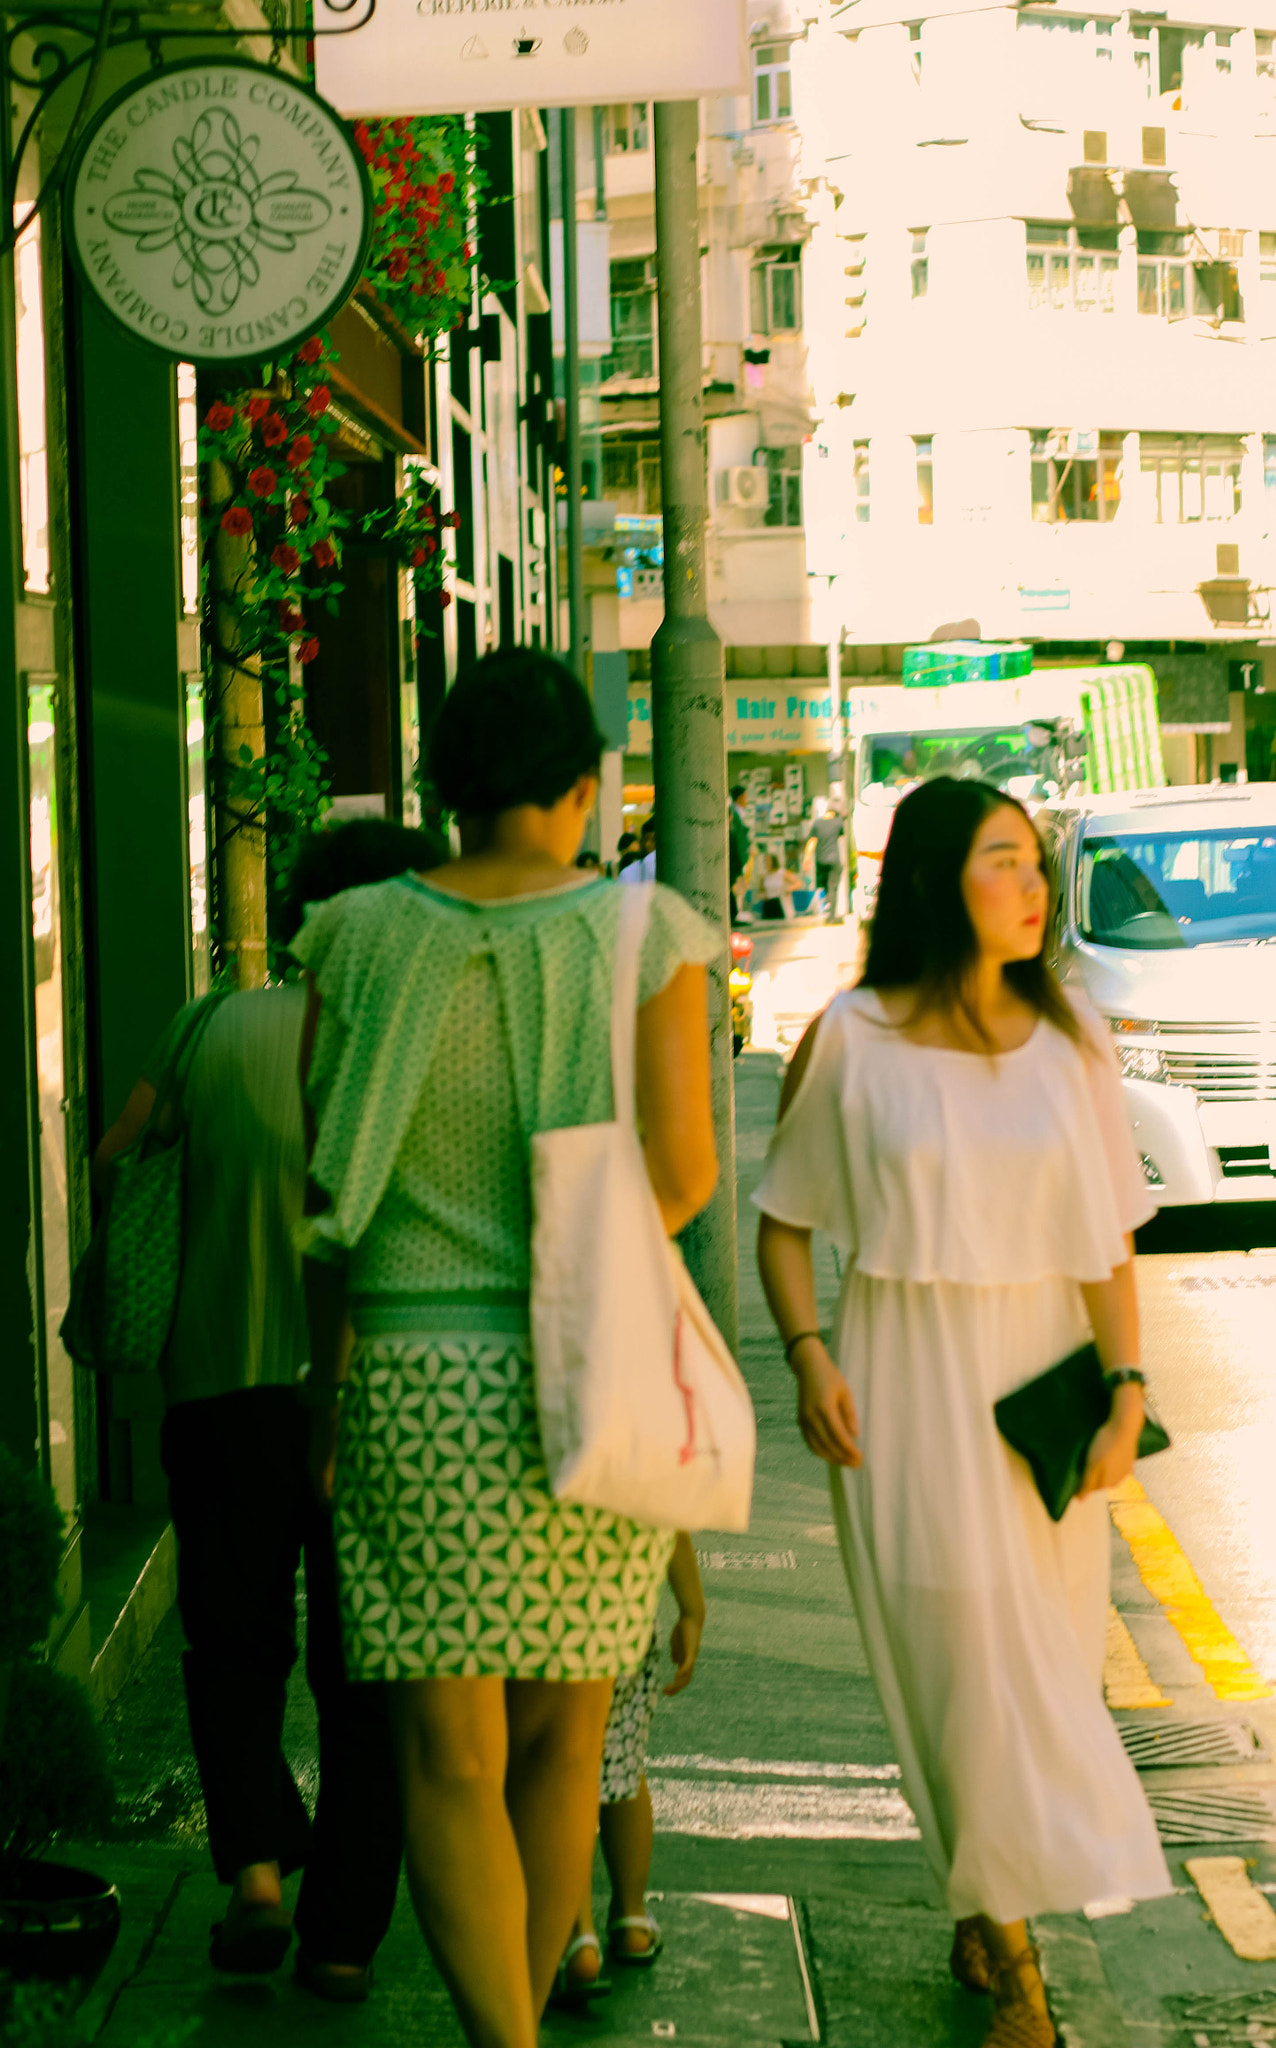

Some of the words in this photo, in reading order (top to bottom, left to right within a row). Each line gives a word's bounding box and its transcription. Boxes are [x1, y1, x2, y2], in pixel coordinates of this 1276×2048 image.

[87, 127, 128, 183] THE
[126, 75, 239, 127] CANDLE
[249, 82, 349, 190] COMPANY
[87, 238, 189, 342] COMPANY
[306, 241, 347, 297] THE
[199, 296, 309, 349] CANDLE
[736, 696, 776, 719] Hair
